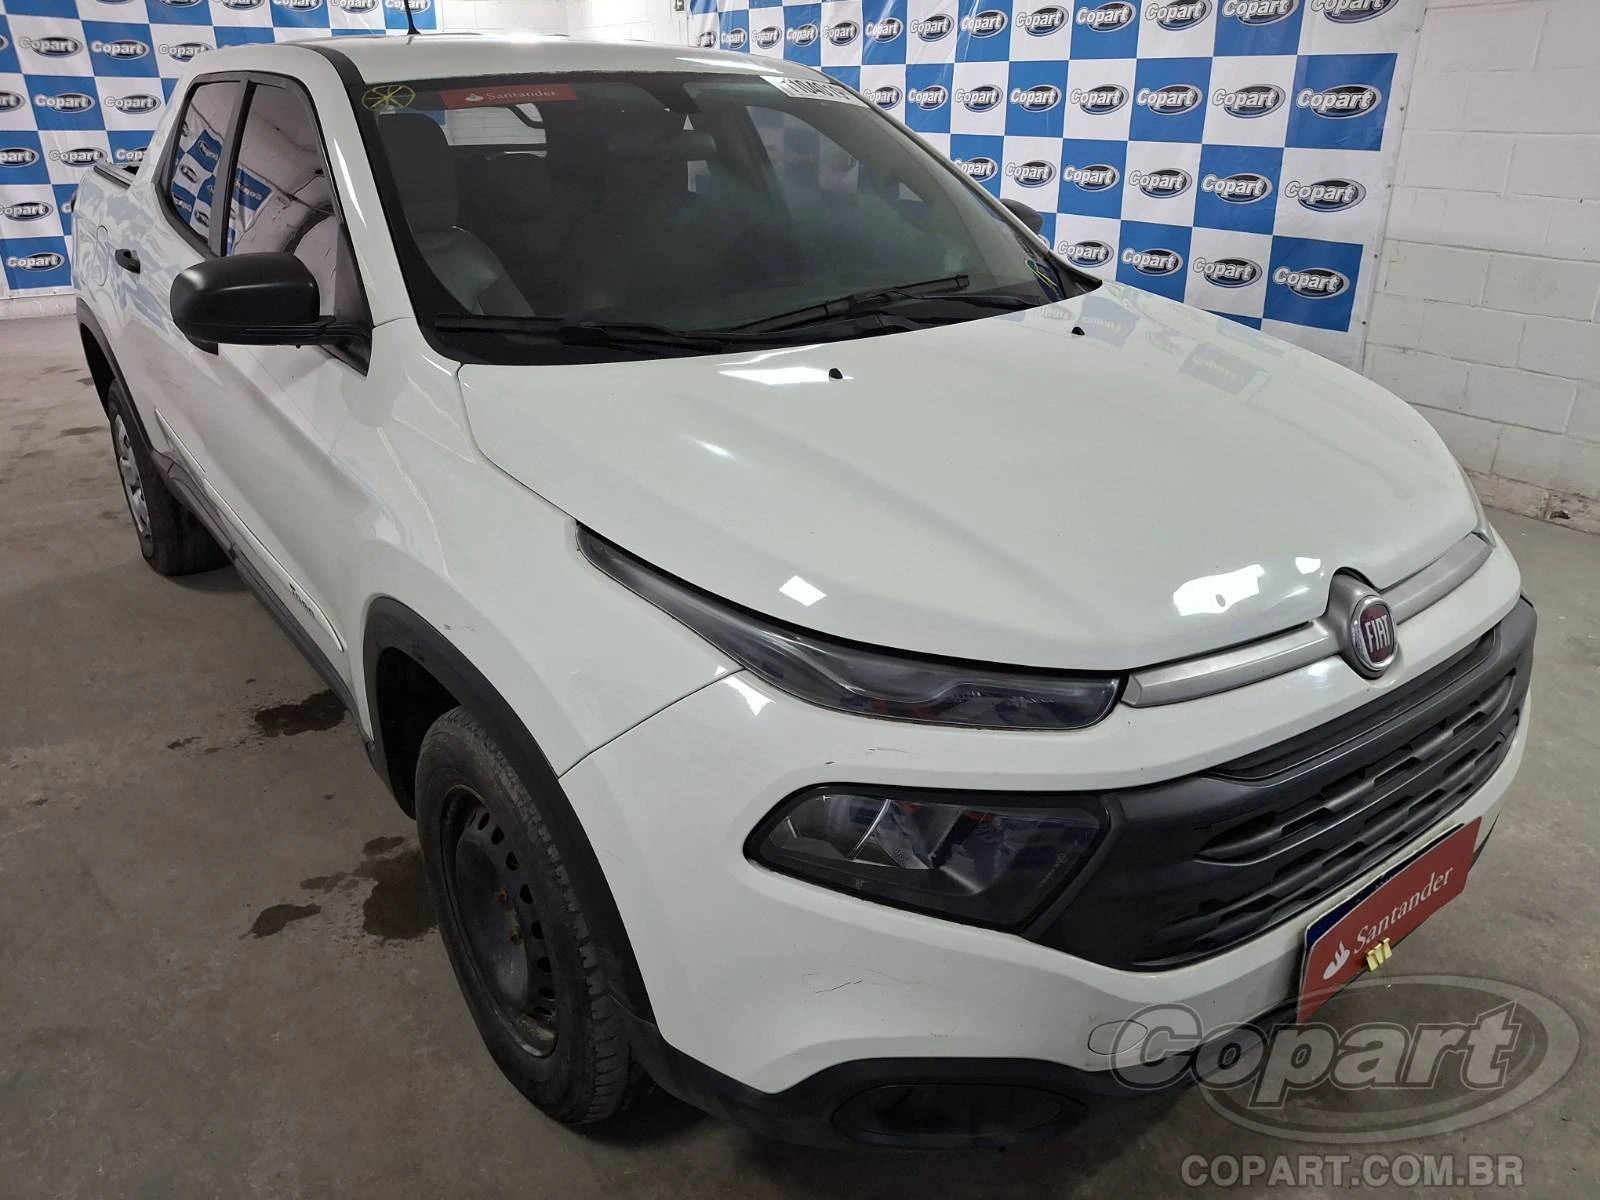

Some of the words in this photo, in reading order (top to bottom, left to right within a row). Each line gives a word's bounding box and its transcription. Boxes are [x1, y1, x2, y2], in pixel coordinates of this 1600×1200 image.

[1076, 7, 1129, 28] Copart
[1145, 2, 1202, 24] Copart
[1222, 0, 1289, 20] Copart
[1311, 0, 1384, 16] Copart
[866, 22, 898, 39] Copart
[910, 20, 948, 37] Copart
[961, 16, 1002, 34] Copart
[1016, 11, 1063, 31] Copart
[721, 32, 745, 46] Copart
[751, 30, 778, 46] Copart
[787, 28, 815, 44] Copart
[823, 25, 854, 42] Copart
[19, 37, 76, 53] Copart
[91, 41, 143, 55] Copart
[34, 94, 88, 110] Copart
[105, 97, 153, 110] Copart
[486, 89, 557, 100] Santander
[909, 88, 946, 105] Copart
[956, 88, 998, 106] Copart
[1010, 88, 1056, 107] Copart
[1071, 89, 1122, 109] Copart
[1137, 88, 1197, 109] Copart
[1212, 88, 1278, 111] Copart
[1297, 88, 1373, 112] Copart
[50, 150, 100, 163] Copart
[116, 149, 146, 162] Cop
[1006, 162, 1050, 181] Copart
[1064, 166, 1115, 186] Copart
[1130, 170, 1184, 191] Copart
[1202, 174, 1265, 197] Copart
[1284, 180, 1356, 204] Copart
[1058, 241, 1107, 261] Copart
[1122, 247, 1175, 269] Copart
[7, 254, 57, 270] Copart
[1193, 257, 1252, 278] Copart
[1273, 266, 1341, 292] Copart
[1364, 614, 1391, 653] FIAT
[1354, 867, 1453, 954] Santander
